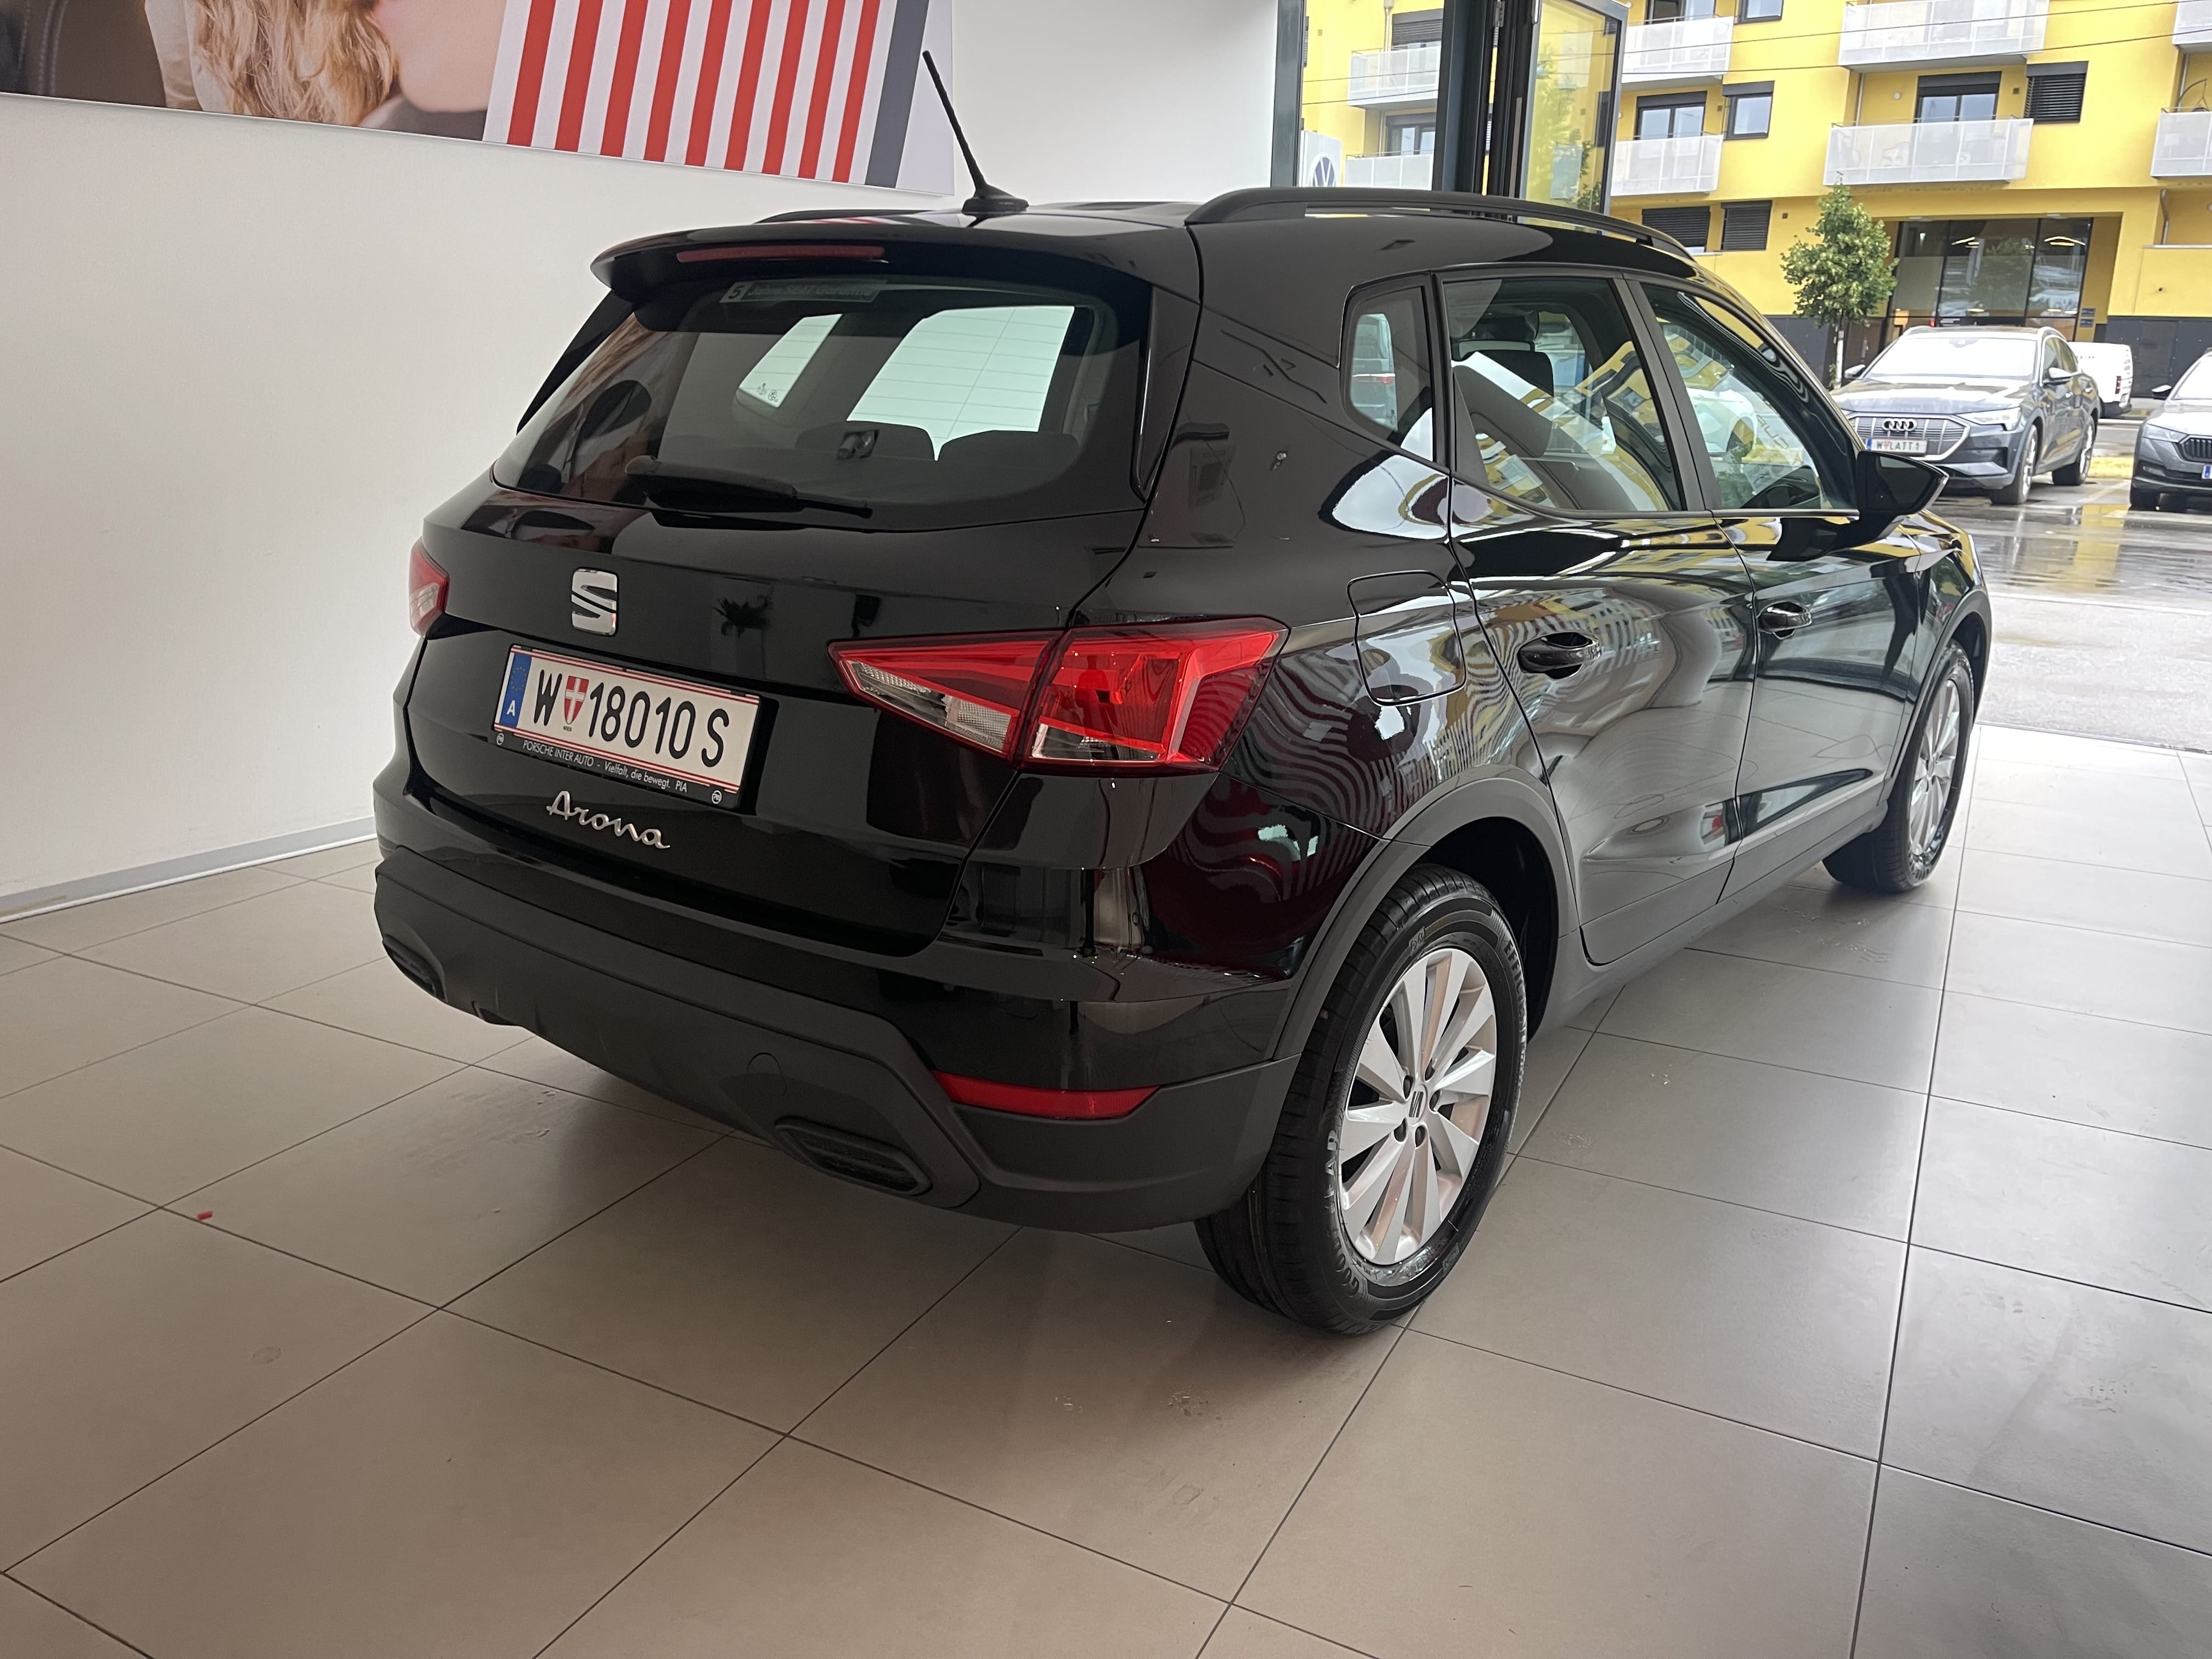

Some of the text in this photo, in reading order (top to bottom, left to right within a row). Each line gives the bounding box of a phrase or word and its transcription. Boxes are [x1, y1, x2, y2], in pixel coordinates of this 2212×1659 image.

[729, 285, 745, 299] 5
[1877, 441, 1883, 449] W
[506, 700, 516, 716] A
[534, 669, 730, 768] W 18010 S
[523, 740, 554, 757] PORSCHE
[554, 747, 574, 761] INTER
[574, 754, 594, 768] AUTO
[605, 760, 629, 778] Vielfalt,
[631, 769, 642, 780] die
[644, 771, 670, 789] bewegt.
[675, 780, 687, 793] PIA
[546, 791, 670, 849] Arona
